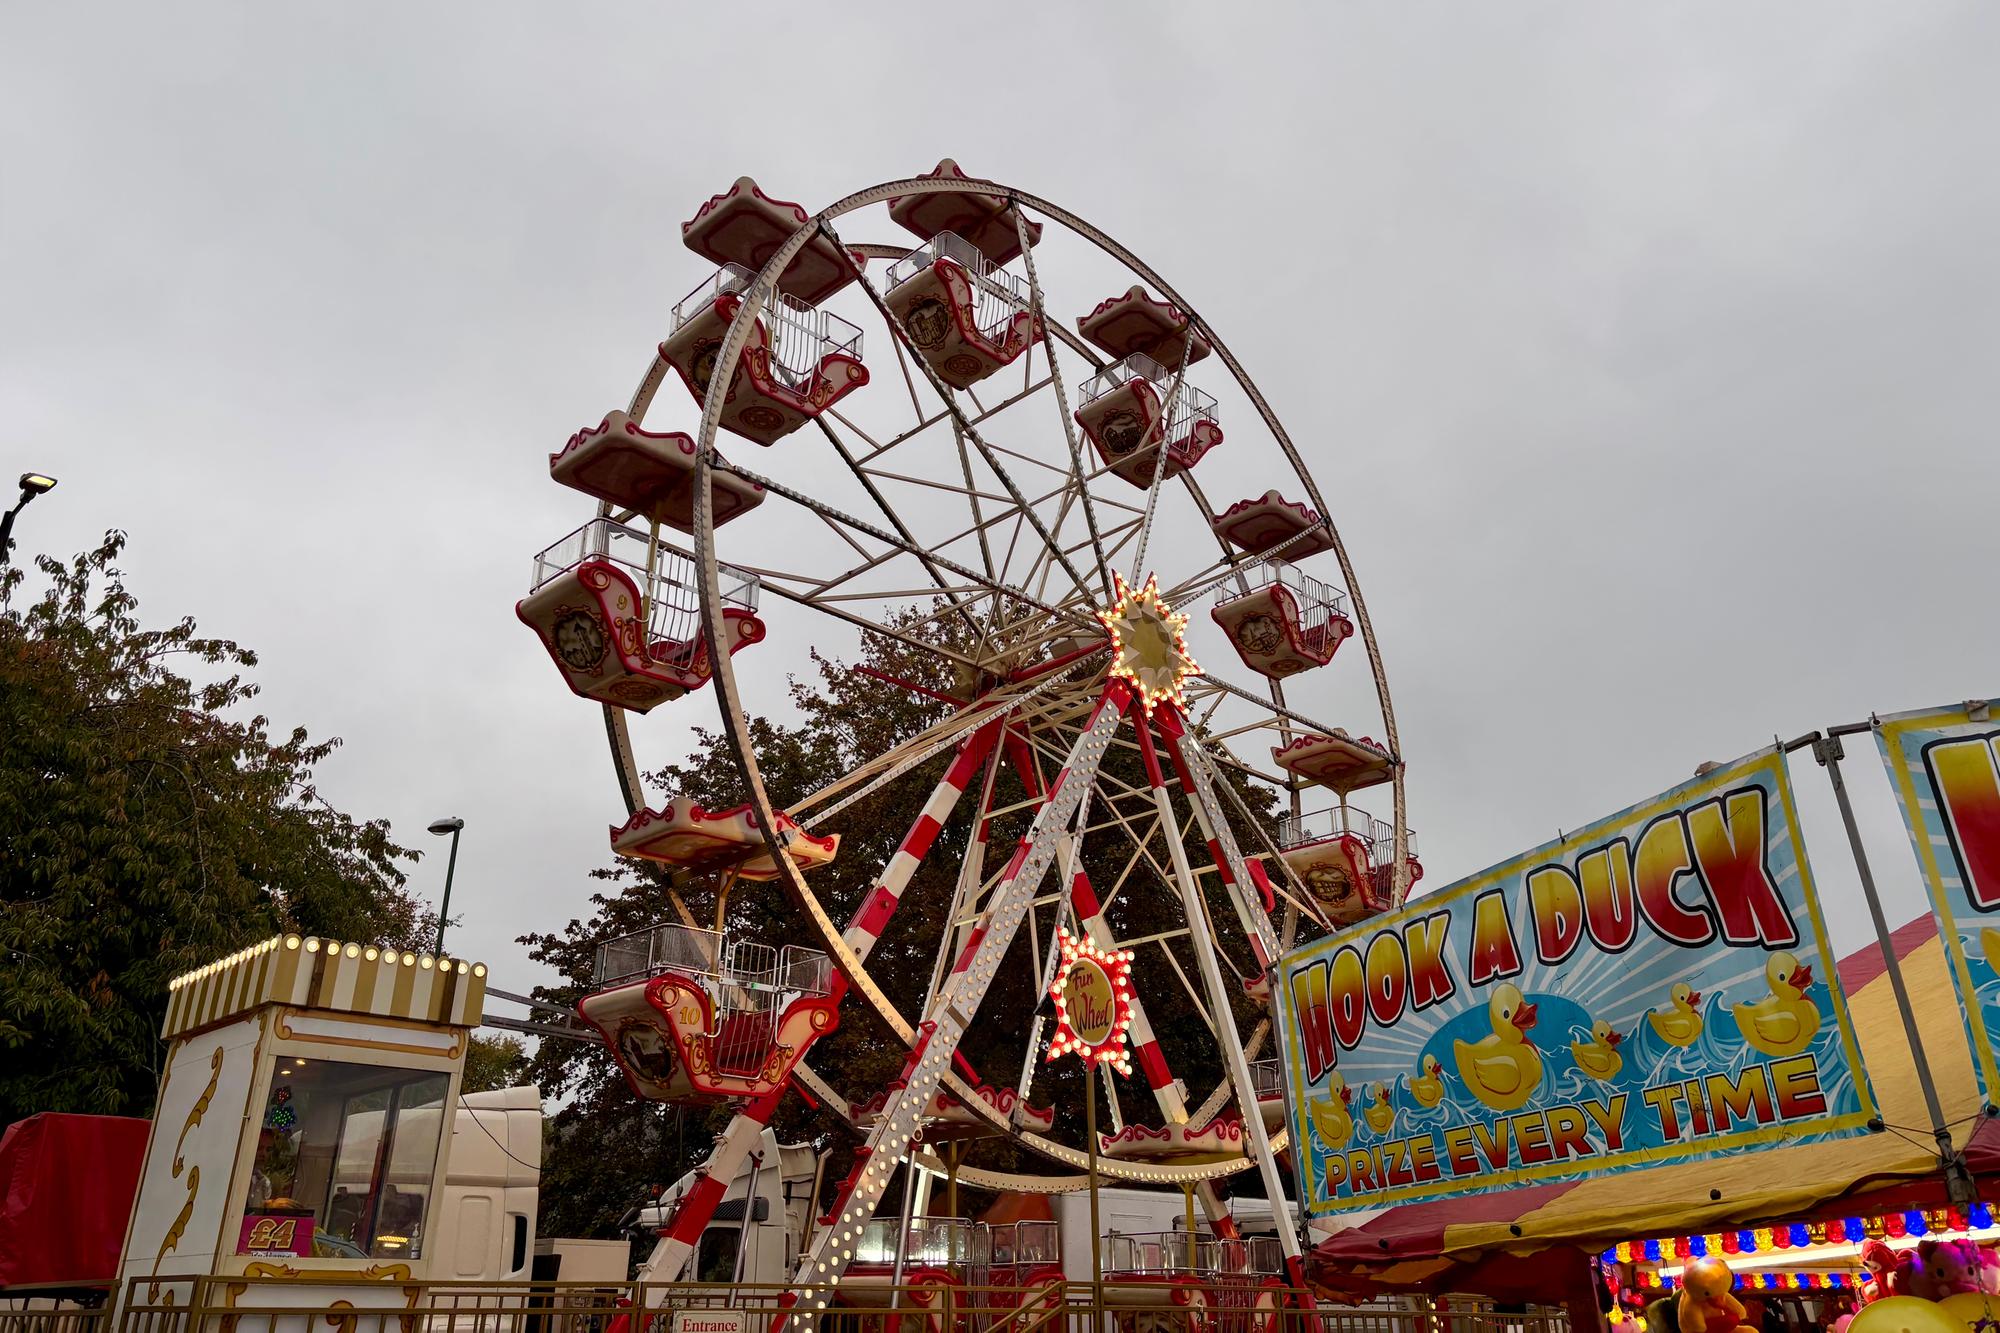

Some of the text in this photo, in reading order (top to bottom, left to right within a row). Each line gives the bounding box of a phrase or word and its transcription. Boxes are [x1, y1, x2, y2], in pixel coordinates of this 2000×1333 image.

[616, 593, 628, 611] 9
[1291, 909, 1457, 1086] HOOK
[1468, 888, 1524, 988] A
[1525, 784, 1800, 967] DUCK
[1069, 966, 1095, 991] Fun
[679, 1006, 701, 1026] 10
[1065, 992, 1112, 1035] Wheel
[1324, 1052, 1828, 1197] PRIZE EVERY TIME
[246, 1217, 297, 1250] £4
[681, 1318, 738, 1333] Entrance
